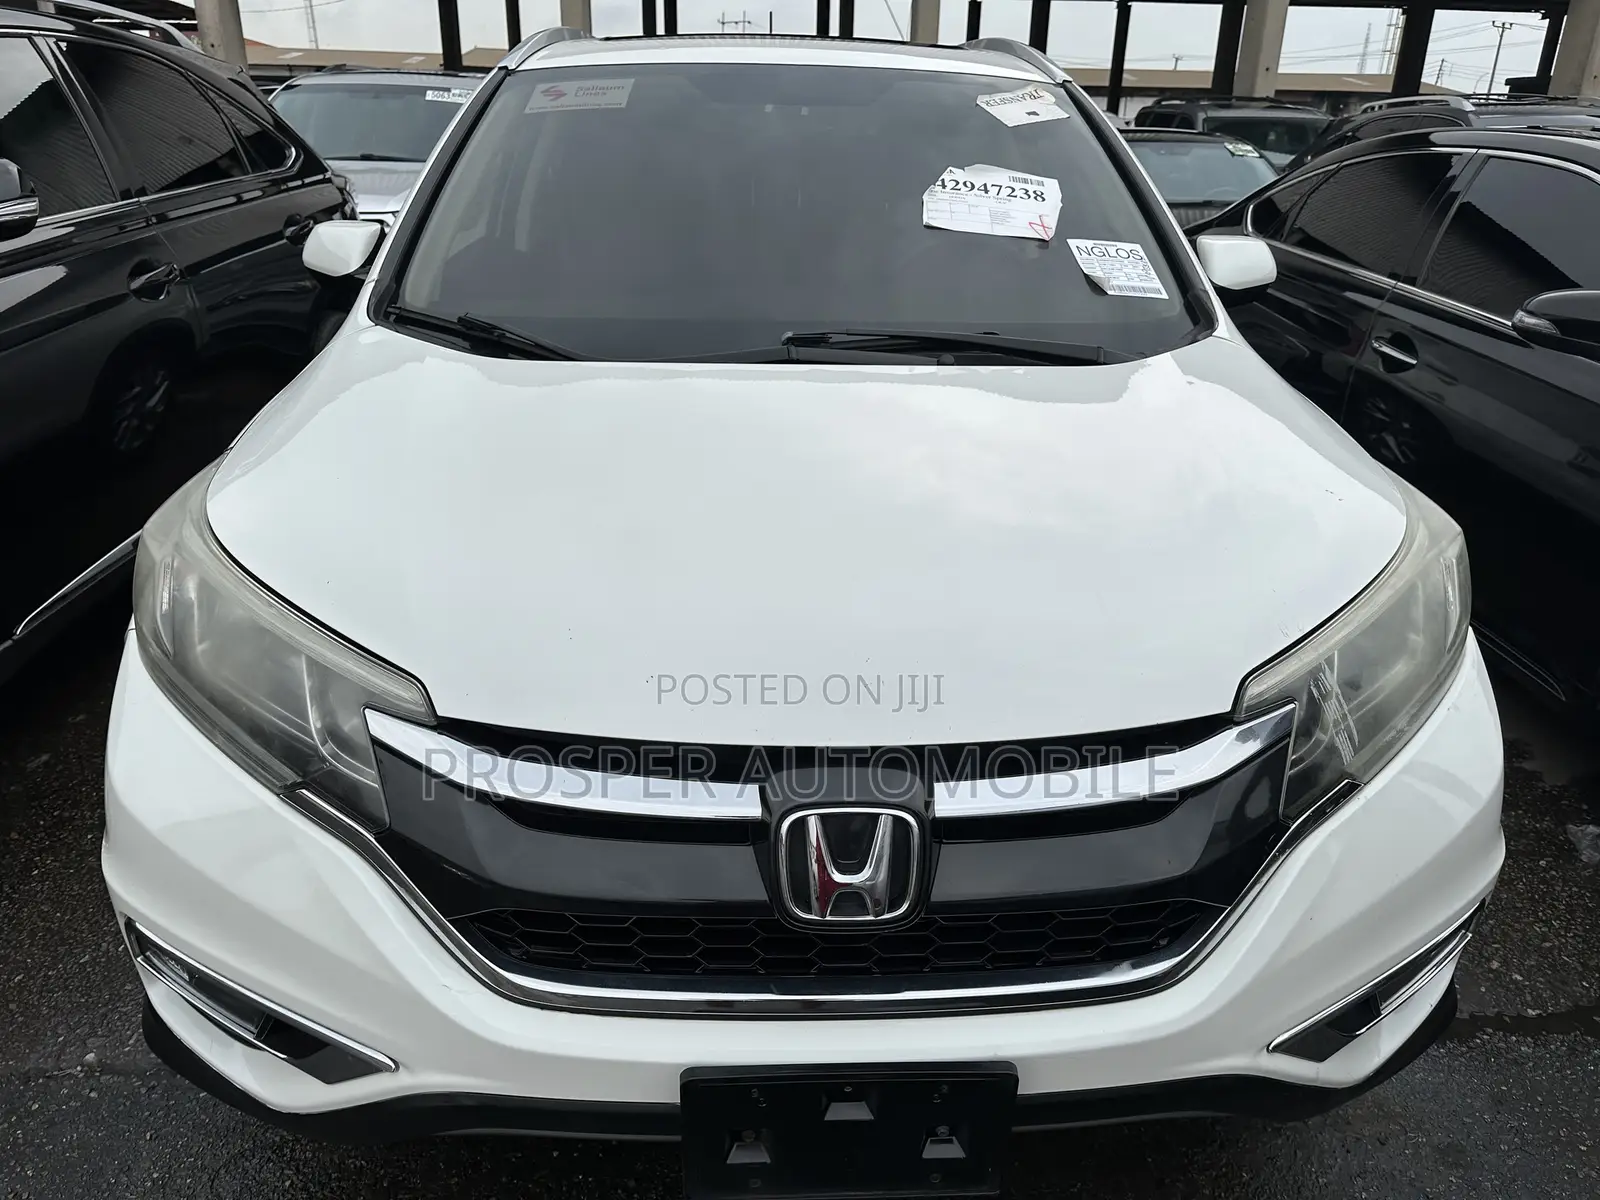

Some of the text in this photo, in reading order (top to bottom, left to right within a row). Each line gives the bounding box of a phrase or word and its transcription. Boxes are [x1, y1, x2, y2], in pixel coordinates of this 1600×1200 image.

[981, 89, 1044, 107] TRANSFER
[937, 178, 1046, 203] 42947238
[1075, 245, 1144, 261] NGLOS
